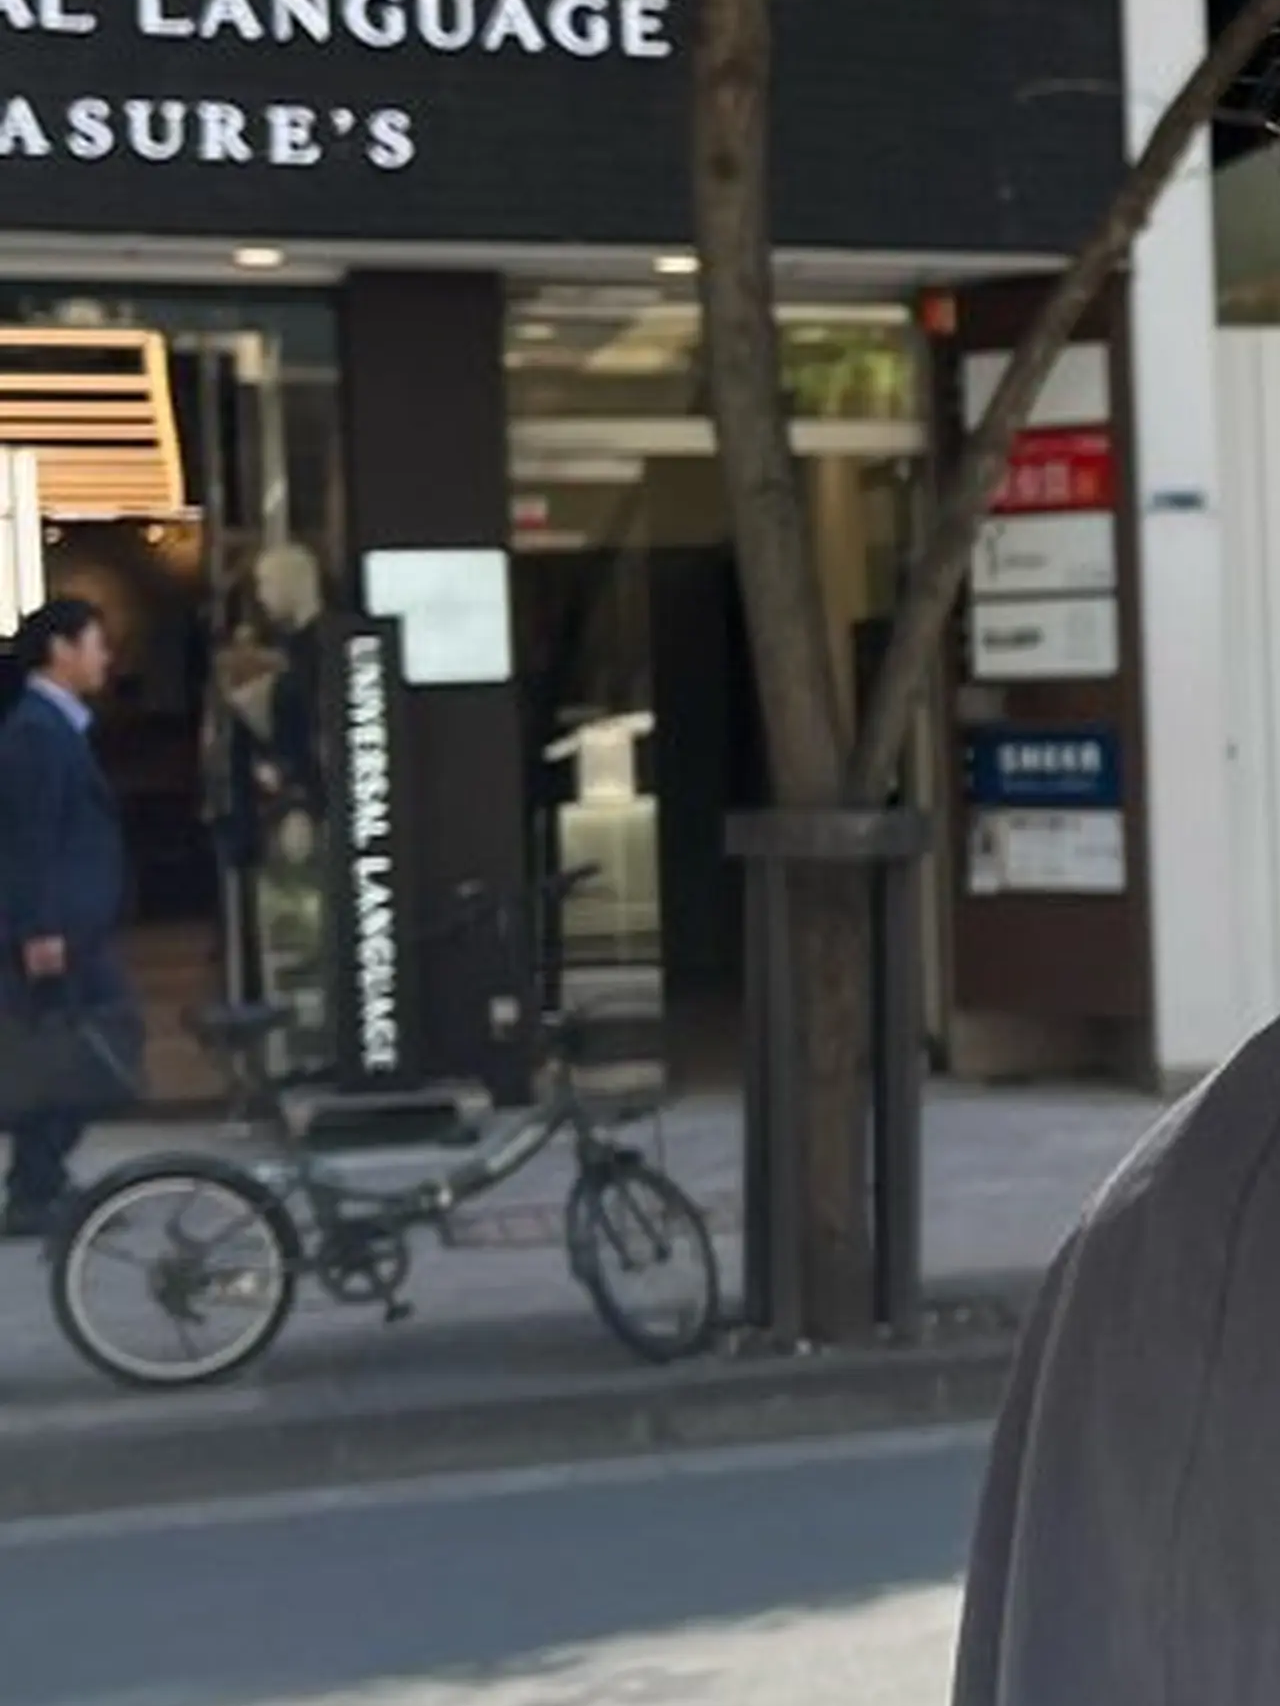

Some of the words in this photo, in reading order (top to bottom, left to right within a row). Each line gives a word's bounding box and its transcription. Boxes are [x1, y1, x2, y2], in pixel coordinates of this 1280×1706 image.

[0, 96, 415, 168] ASURE'S
[347, 635, 392, 850] UNIVERSAL
[354, 855, 398, 1071] LANGUAGE
